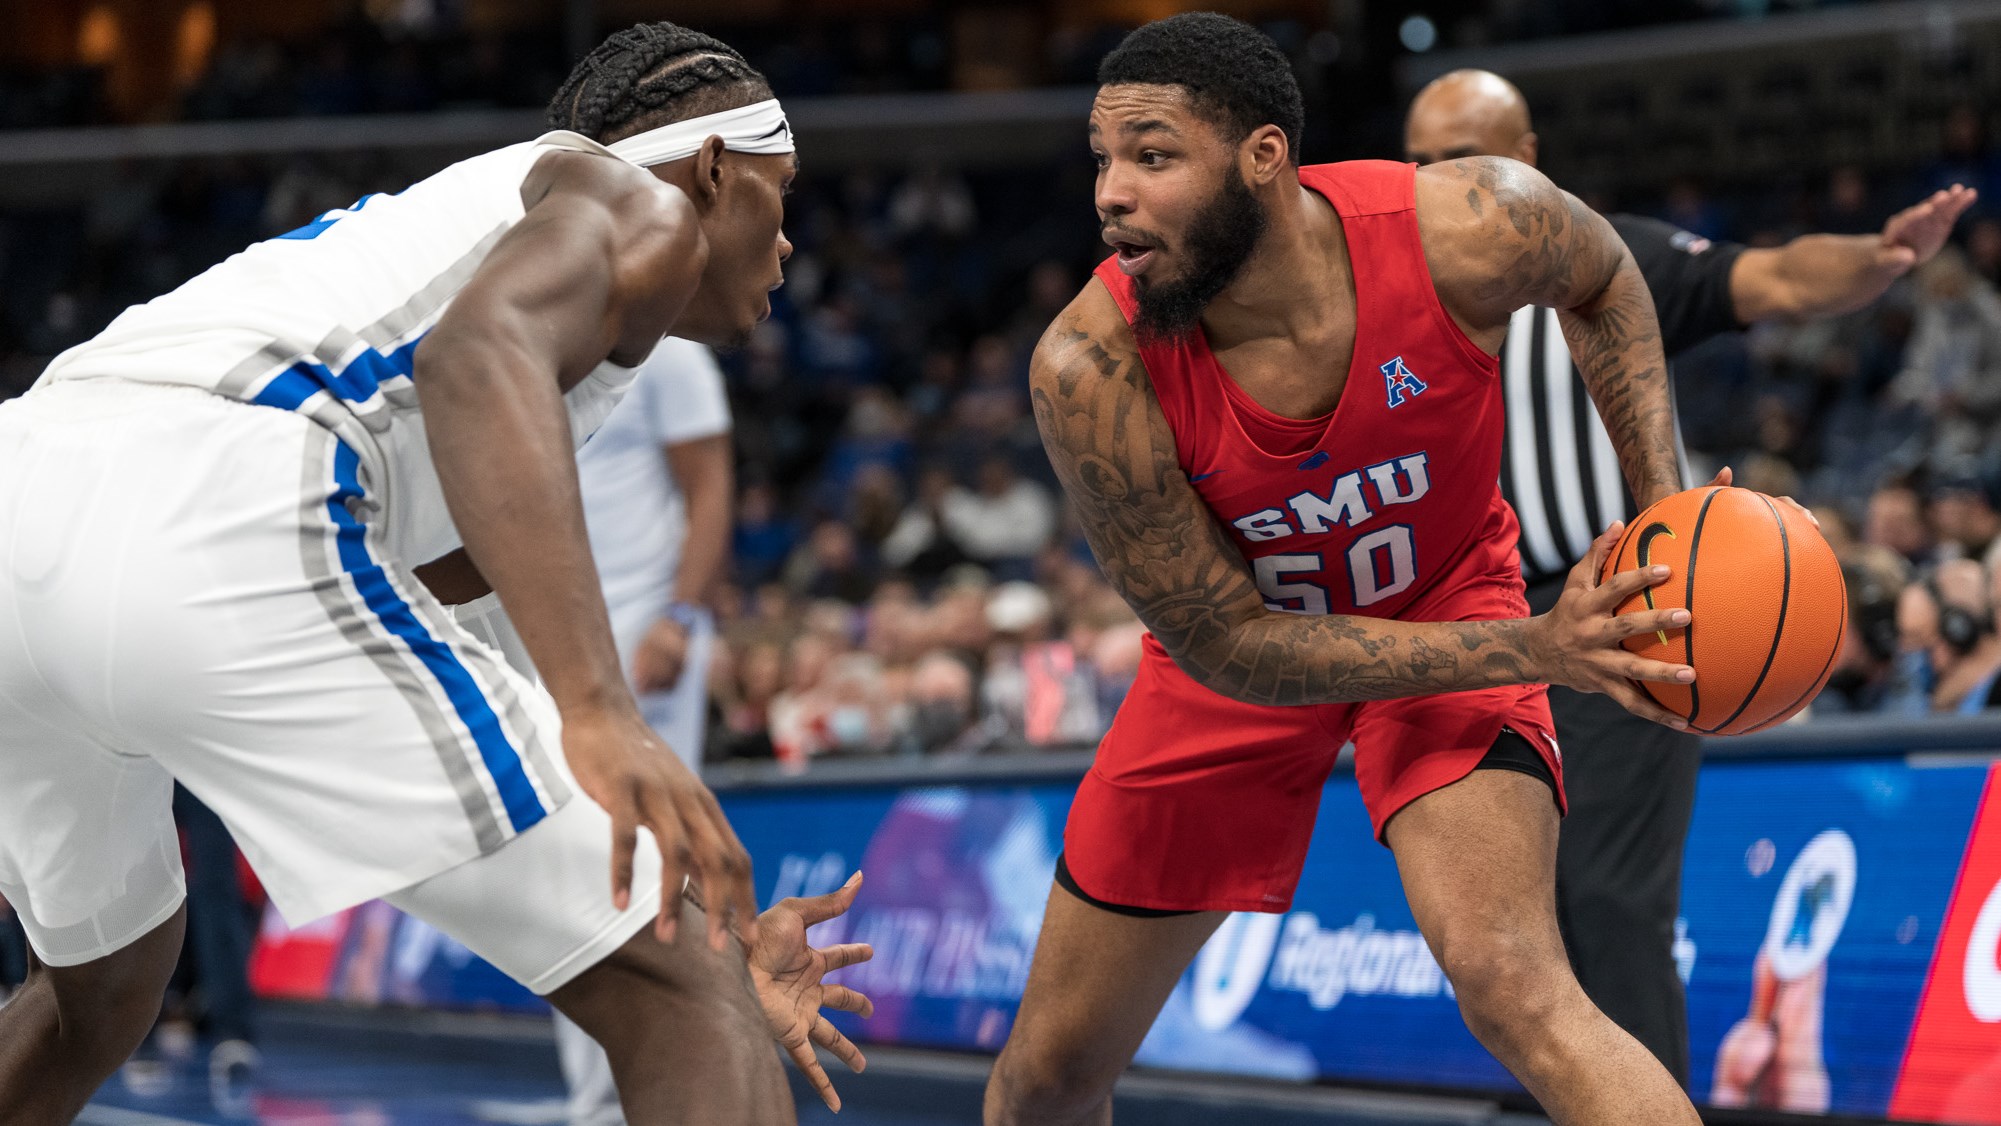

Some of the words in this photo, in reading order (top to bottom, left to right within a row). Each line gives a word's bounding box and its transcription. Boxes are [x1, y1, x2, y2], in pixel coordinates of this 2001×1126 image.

[1378, 355, 1428, 409] A
[1232, 450, 1431, 542] SMU
[1251, 523, 1417, 616] 50
